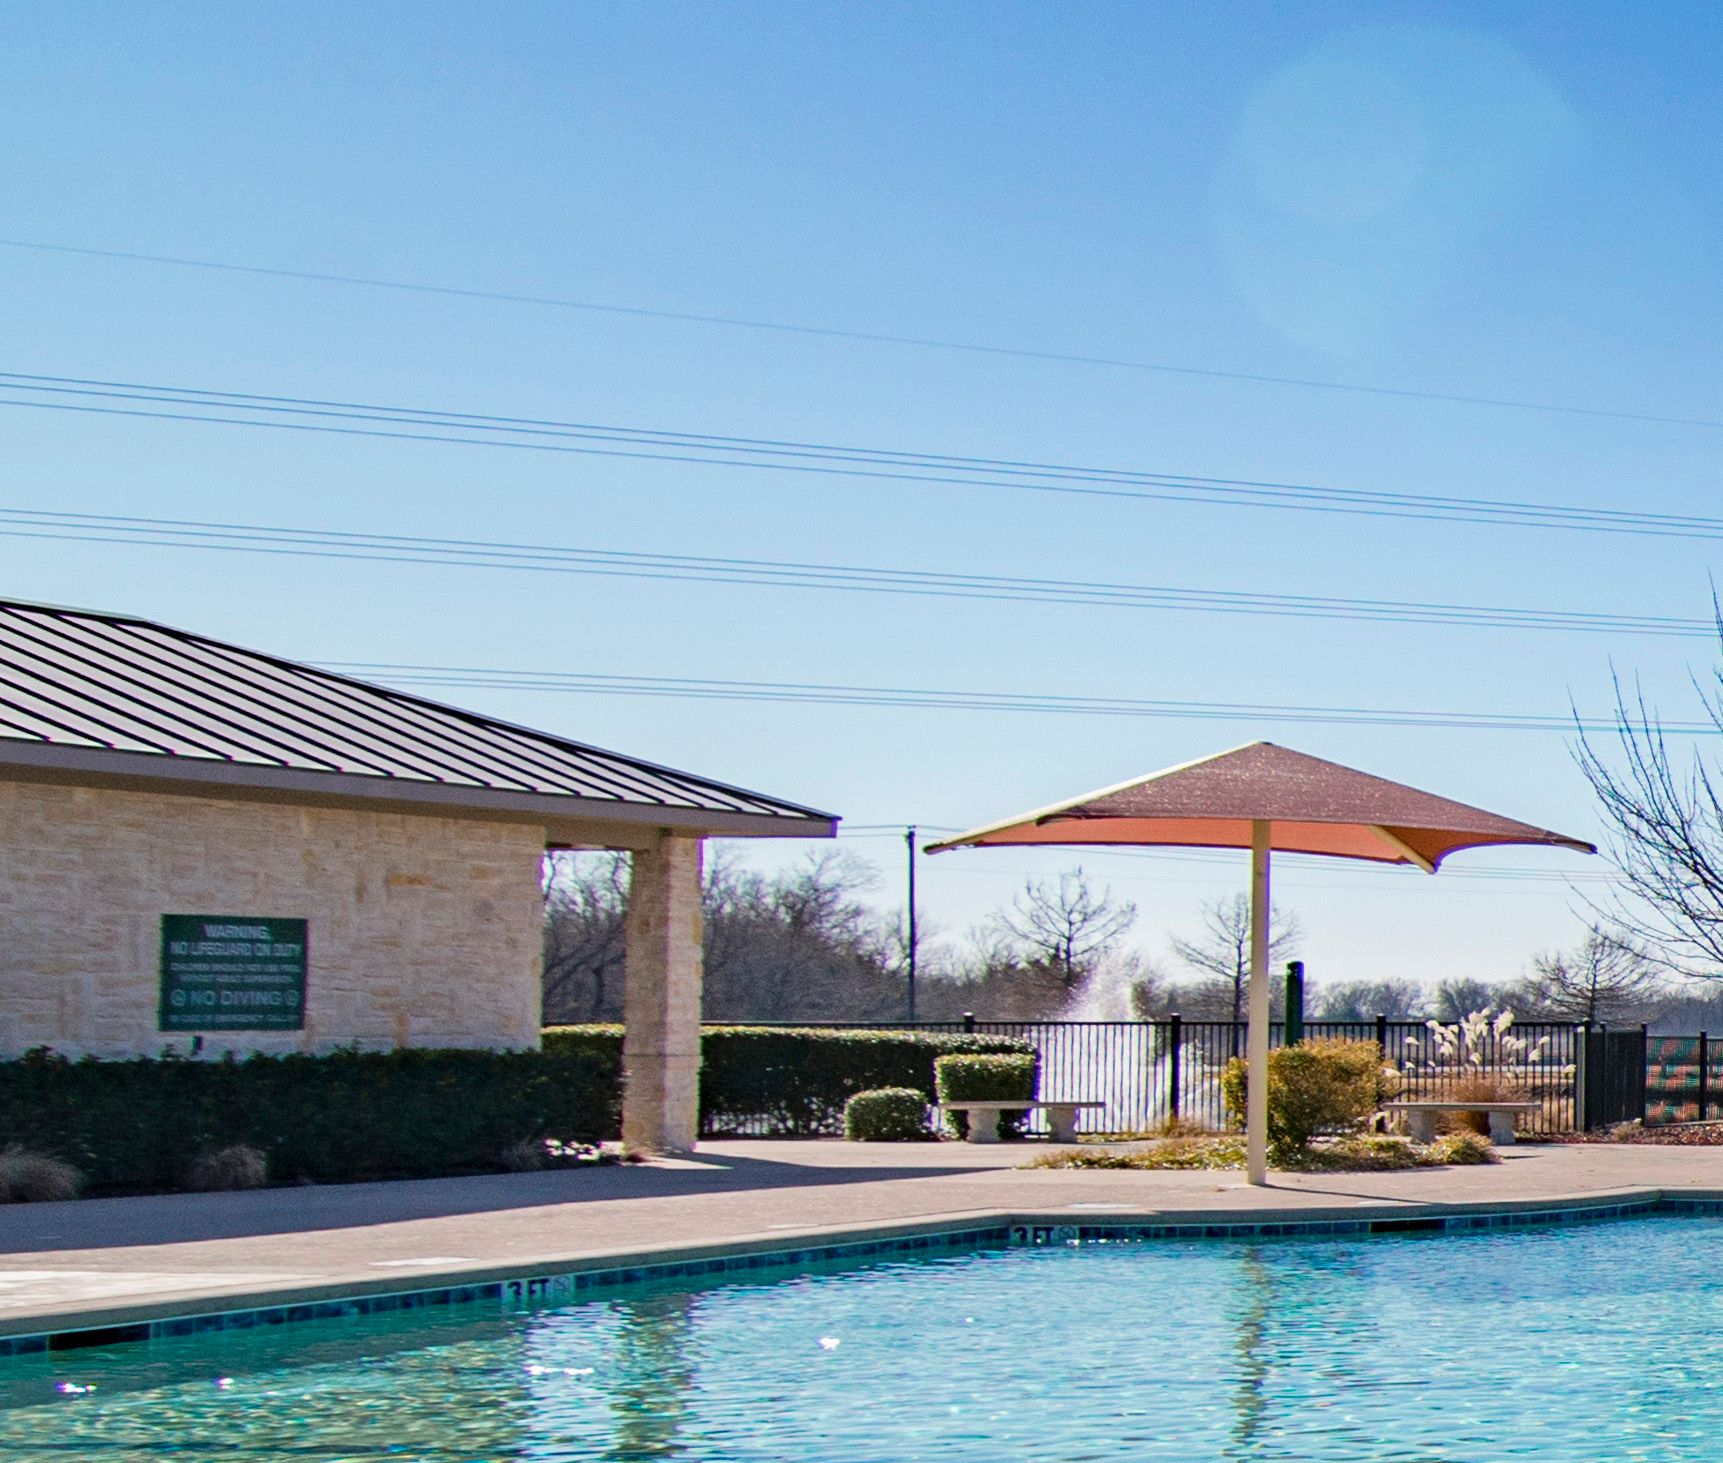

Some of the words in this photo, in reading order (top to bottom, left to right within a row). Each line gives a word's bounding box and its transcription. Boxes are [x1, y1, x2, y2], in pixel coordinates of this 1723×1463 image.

[170, 941, 188, 954] NO
[190, 941, 252, 956] LIFEGUARD
[254, 942, 271, 956] ON
[273, 943, 302, 957] DUTY
[190, 990, 217, 1006] NO
[220, 990, 283, 1006] DIVING
